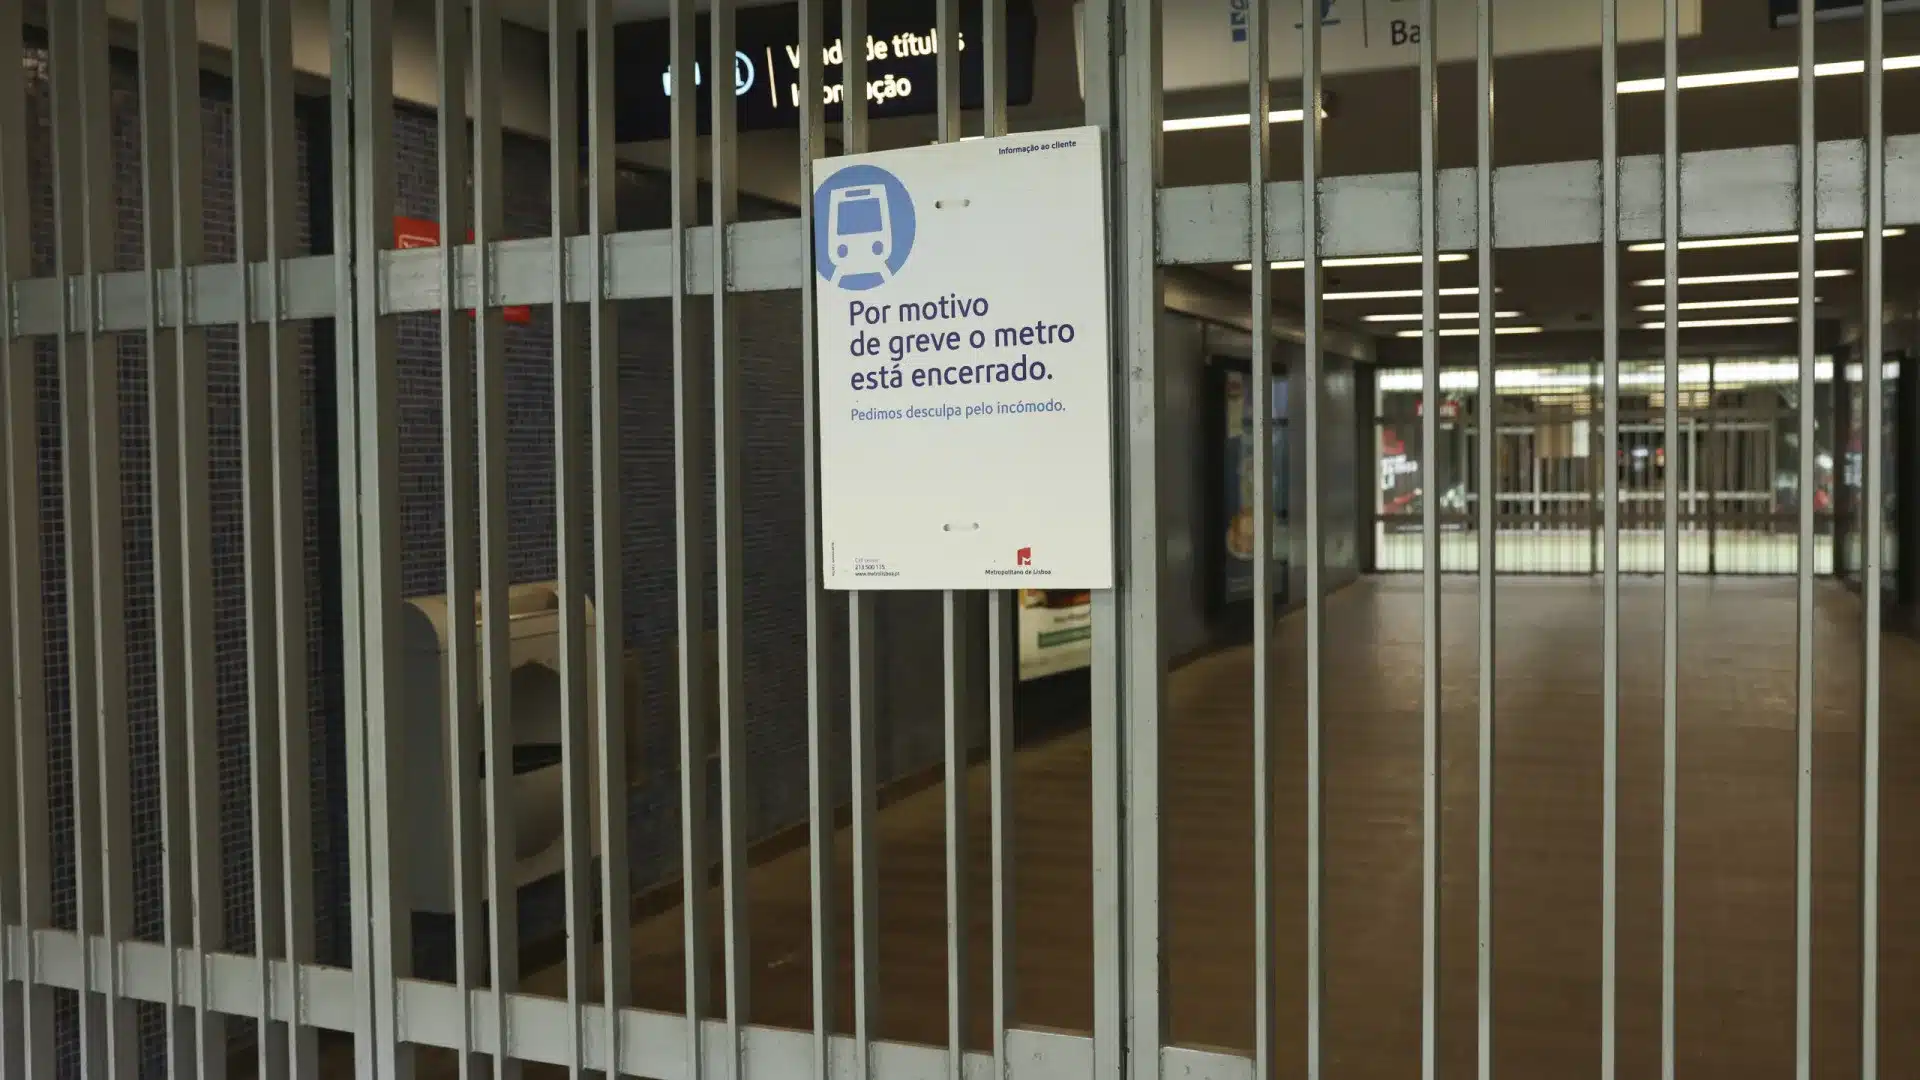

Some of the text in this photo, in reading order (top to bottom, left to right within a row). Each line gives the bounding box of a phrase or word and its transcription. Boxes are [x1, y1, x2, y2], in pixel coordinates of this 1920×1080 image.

[891, 27, 966, 57] títuls
[1390, 20, 1421, 46] Ba
[998, 145, 1040, 155] Informação
[1051, 140, 1077, 149] cliente
[849, 293, 989, 326] Por motivo
[850, 320, 1075, 361] de greve o metro
[850, 353, 1053, 391] está encerrado.
[851, 397, 1066, 421] Pedimos desculpa pelo incómodo.
